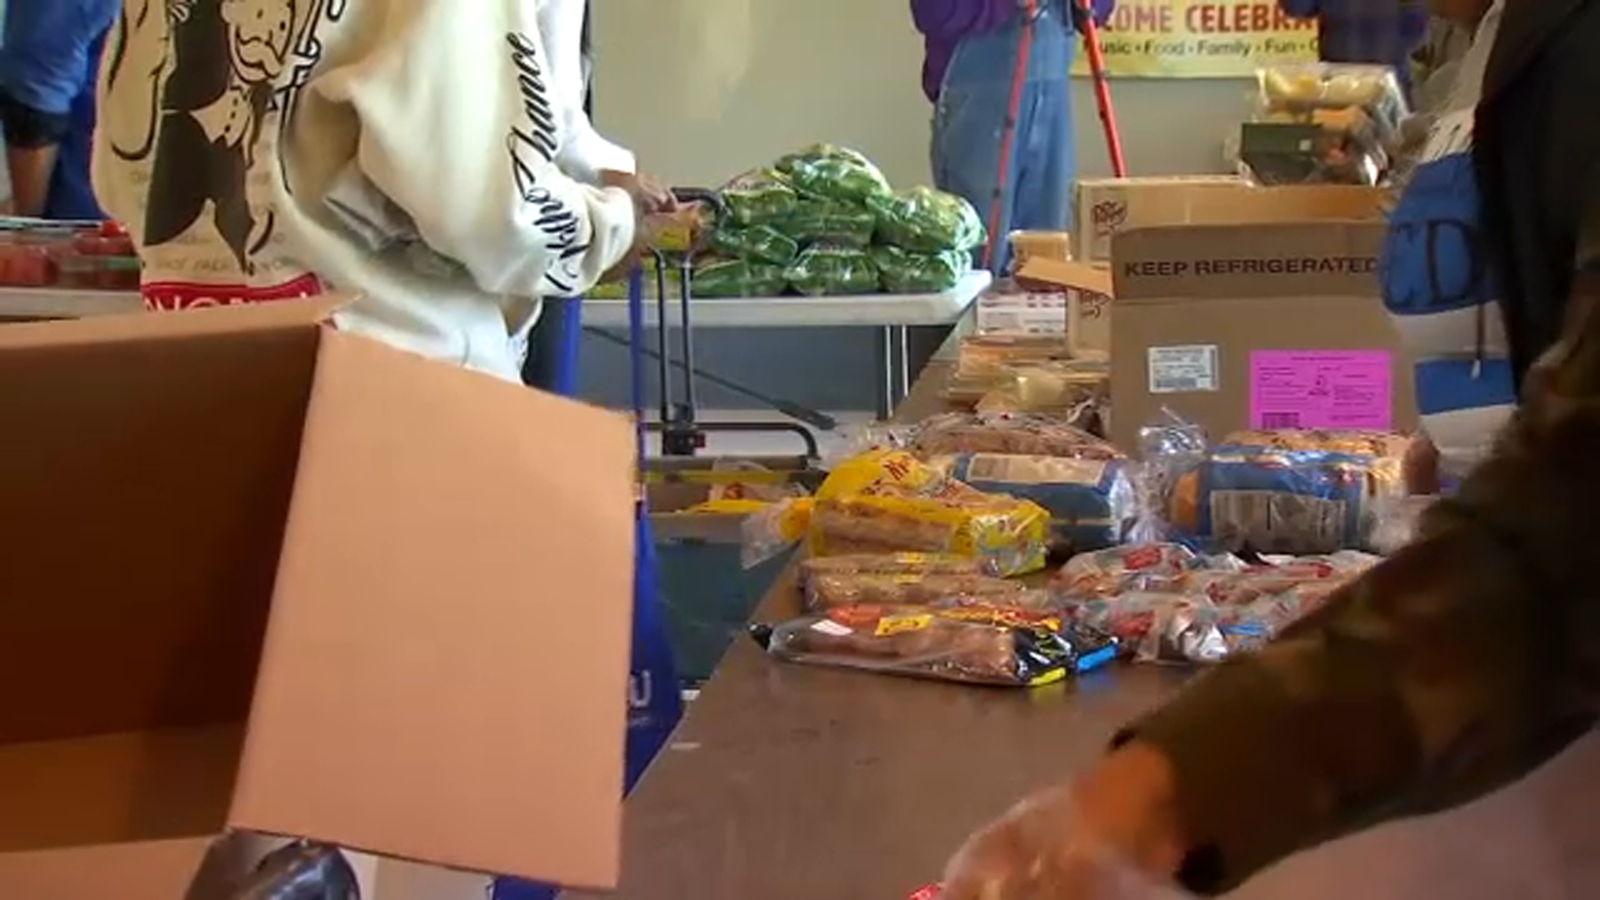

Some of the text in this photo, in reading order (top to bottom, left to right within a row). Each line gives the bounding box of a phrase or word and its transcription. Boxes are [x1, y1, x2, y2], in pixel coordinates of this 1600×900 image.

[1105, 5, 1172, 33] OME
[1084, 39, 1131, 55] usic
[1144, 39, 1185, 55] Food
[1197, 39, 1251, 58] Family
[1264, 37, 1297, 54] Fun
[1124, 256, 1380, 278] KEEP REFRIGERATED
